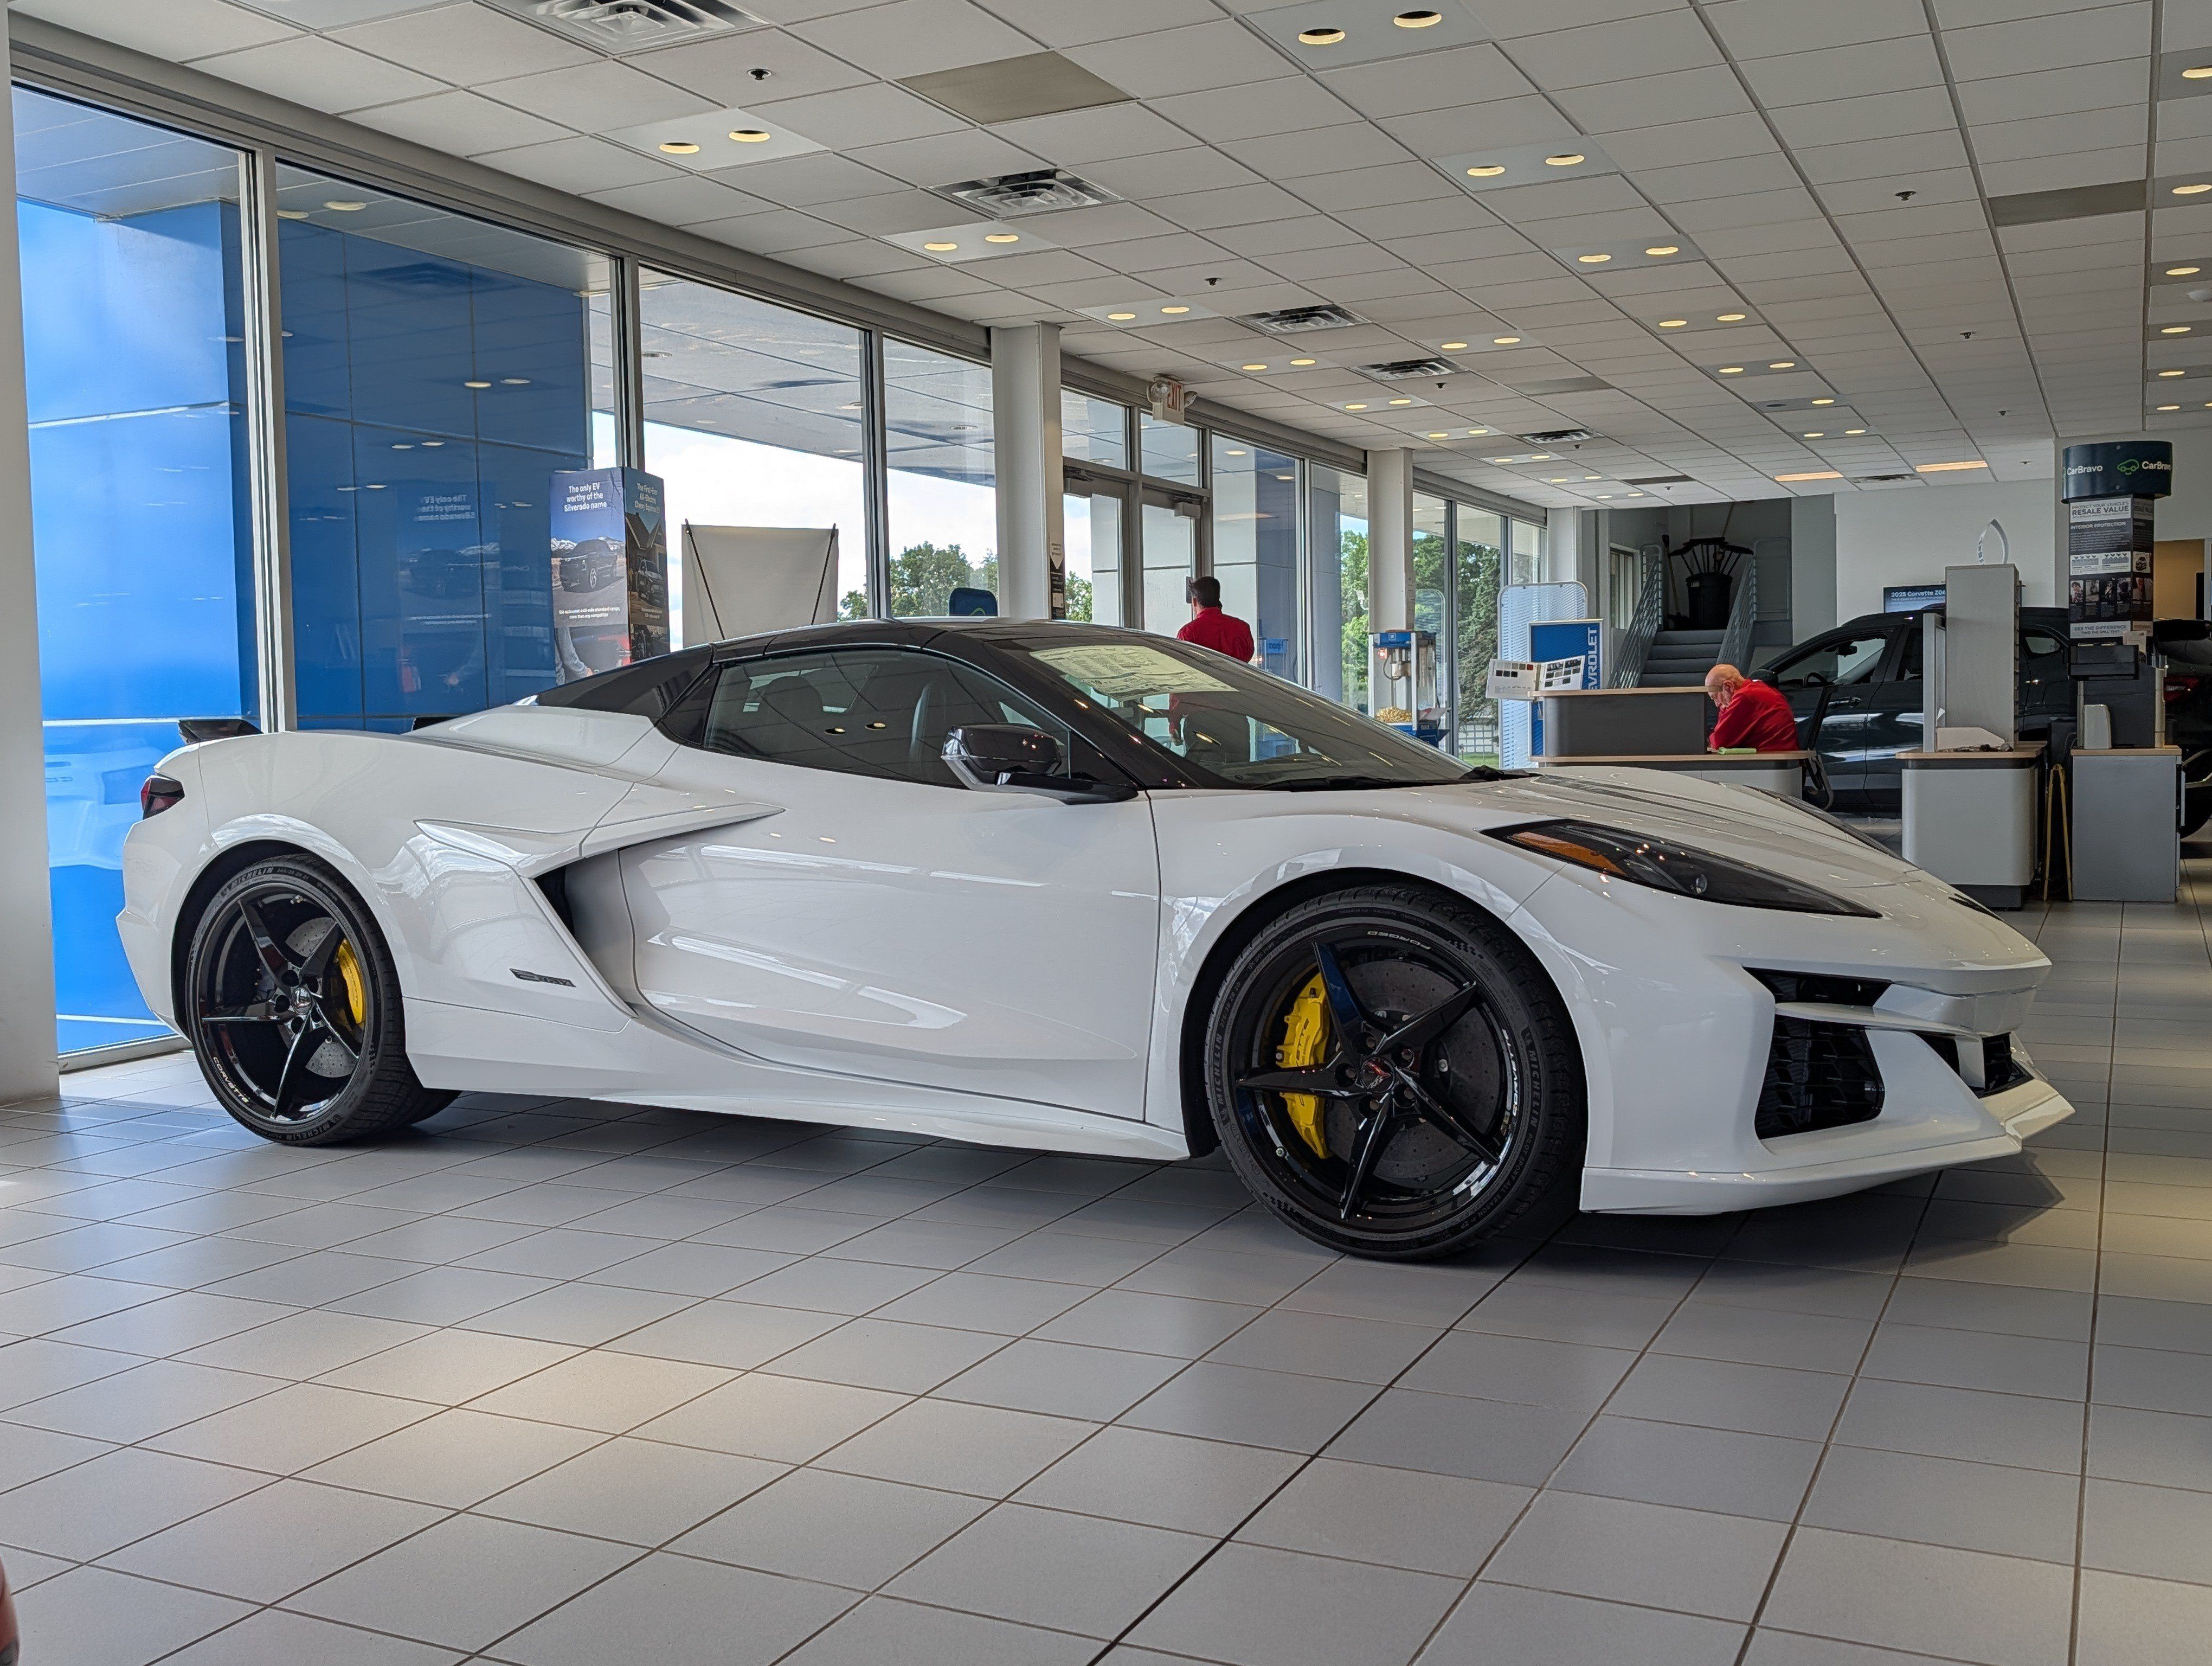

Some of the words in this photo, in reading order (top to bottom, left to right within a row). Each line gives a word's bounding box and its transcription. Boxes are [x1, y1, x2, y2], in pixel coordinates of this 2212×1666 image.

[1167, 381, 1181, 411] EXIT
[2067, 465, 2103, 475] CarBravo
[567, 494, 586, 503] worthy
[580, 483, 591, 492] only
[593, 482, 600, 490] EV
[564, 503, 590, 512] Silverado
[591, 501, 607, 509] name
[230, 866, 274, 889] MICHELIN
[1367, 931, 1431, 949] FORGED
[213, 1057, 249, 1103] CORVETTE
[1213, 1032, 1224, 1105] MICHELIN
[1528, 1049, 1540, 1128] MICHELIN
[286, 1121, 330, 1141] MICHELIN
[1519, 1132, 1534, 1162] PILOT
[1509, 1155, 1525, 1181] SPORT
[1499, 1180, 1512, 1194] ALL
[1476, 1193, 1501, 1218] SEASON
